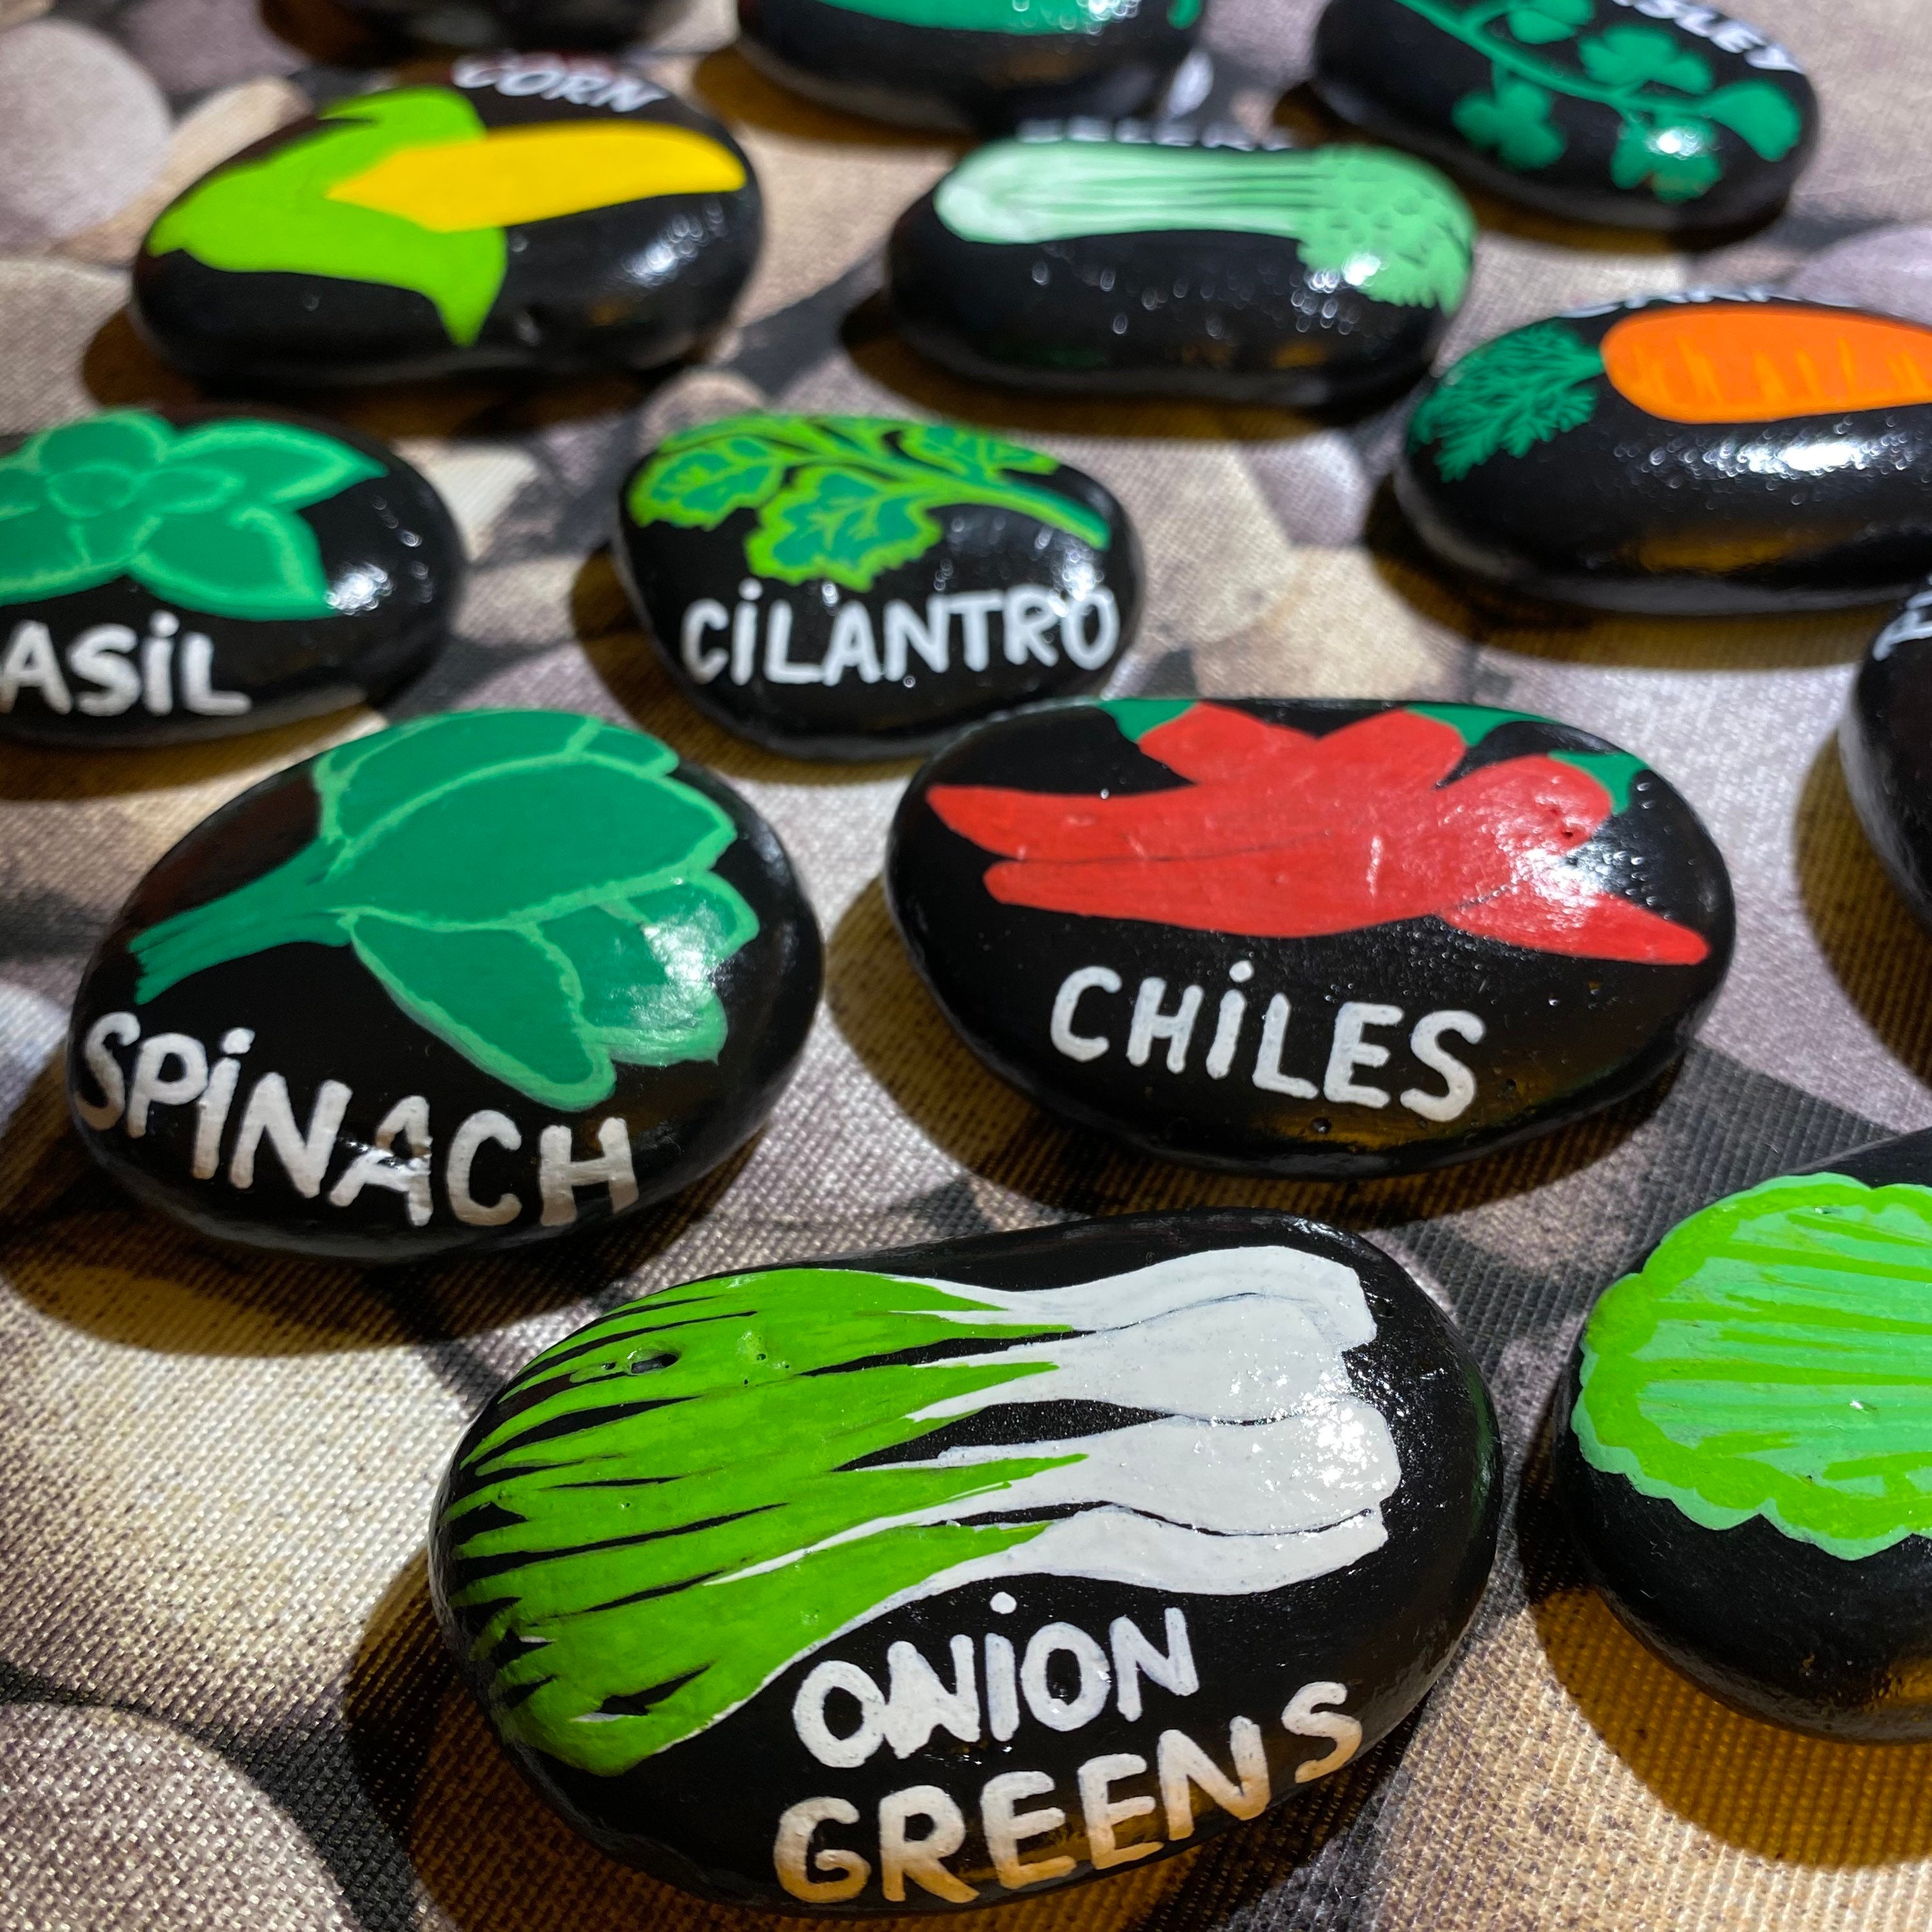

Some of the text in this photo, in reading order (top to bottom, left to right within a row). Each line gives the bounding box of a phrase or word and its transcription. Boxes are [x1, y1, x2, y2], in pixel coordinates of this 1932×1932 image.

[452, 53, 670, 112] CORN
[1614, 0, 1803, 74] SLEY
[75, 1012, 639, 1226] SPiNACH
[1050, 960, 1485, 1122] CHiLES
[793, 1591, 1198, 1768] ONiON
[773, 1681, 1363, 1904] GREENS
